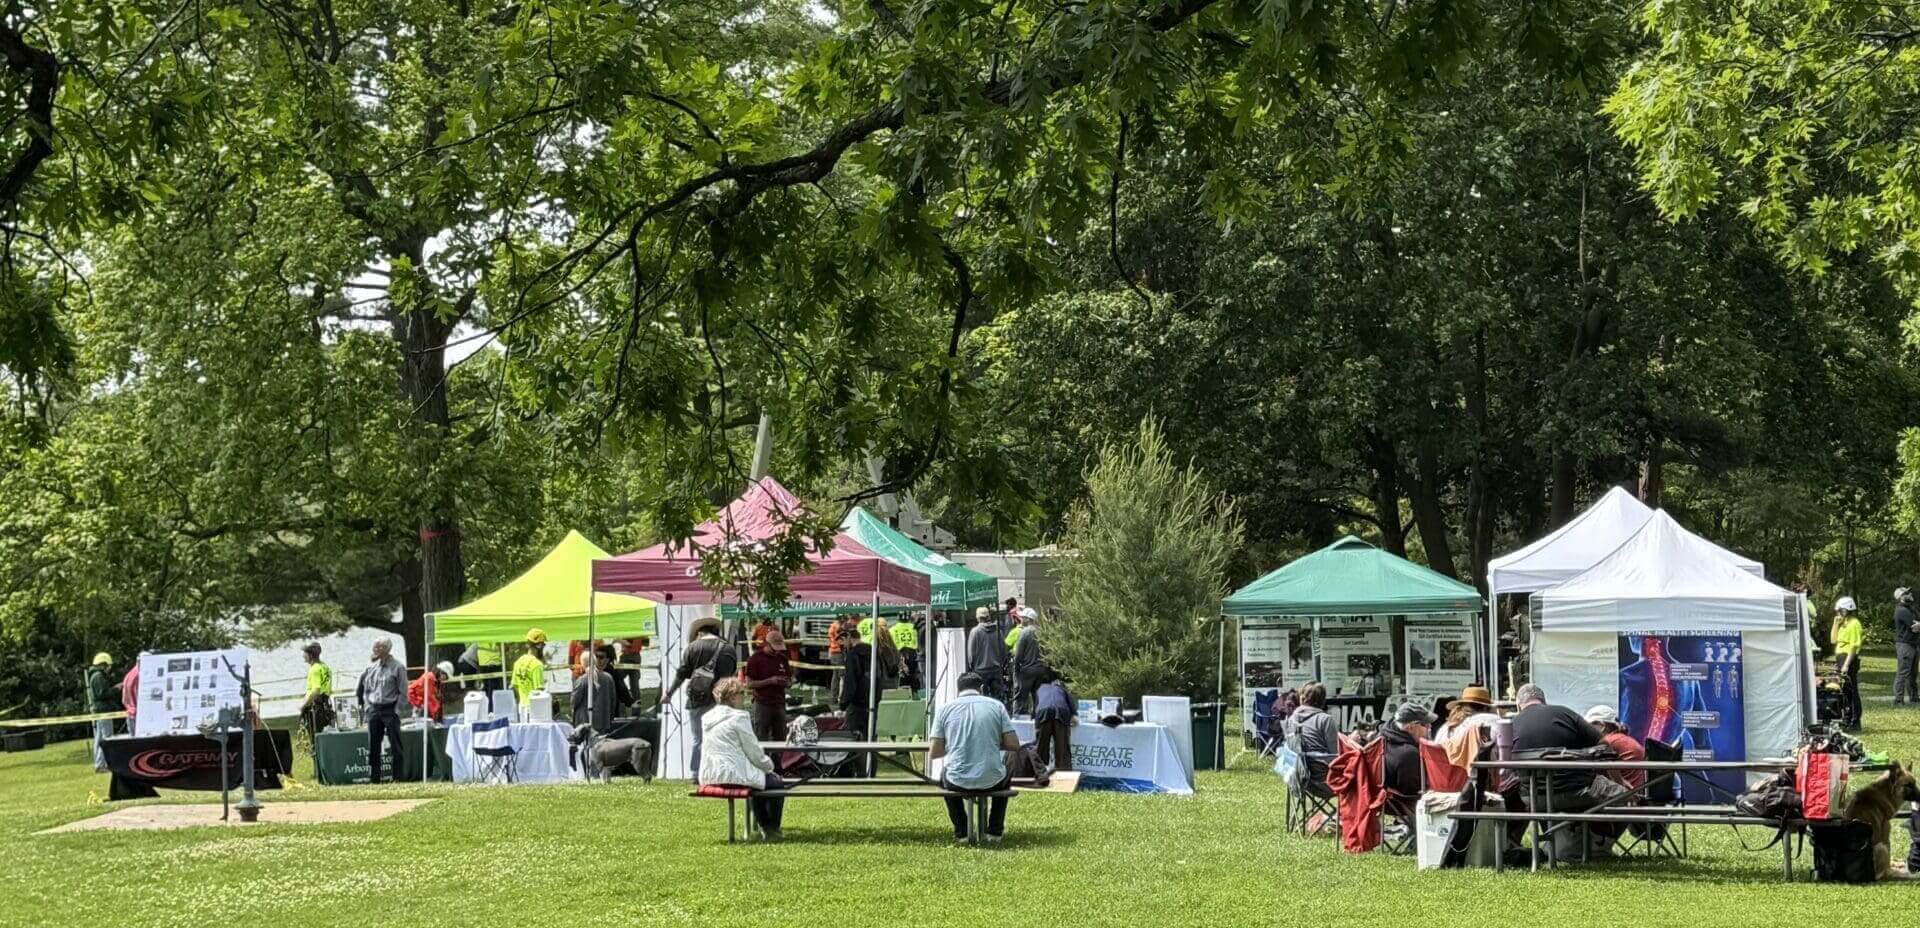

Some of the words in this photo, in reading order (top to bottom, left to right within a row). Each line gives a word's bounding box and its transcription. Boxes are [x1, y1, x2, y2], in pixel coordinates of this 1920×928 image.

[900, 632, 912, 642] 23
[160, 752, 238, 764] GATEWY
[1076, 757, 1133, 768] SOLUTIONS
